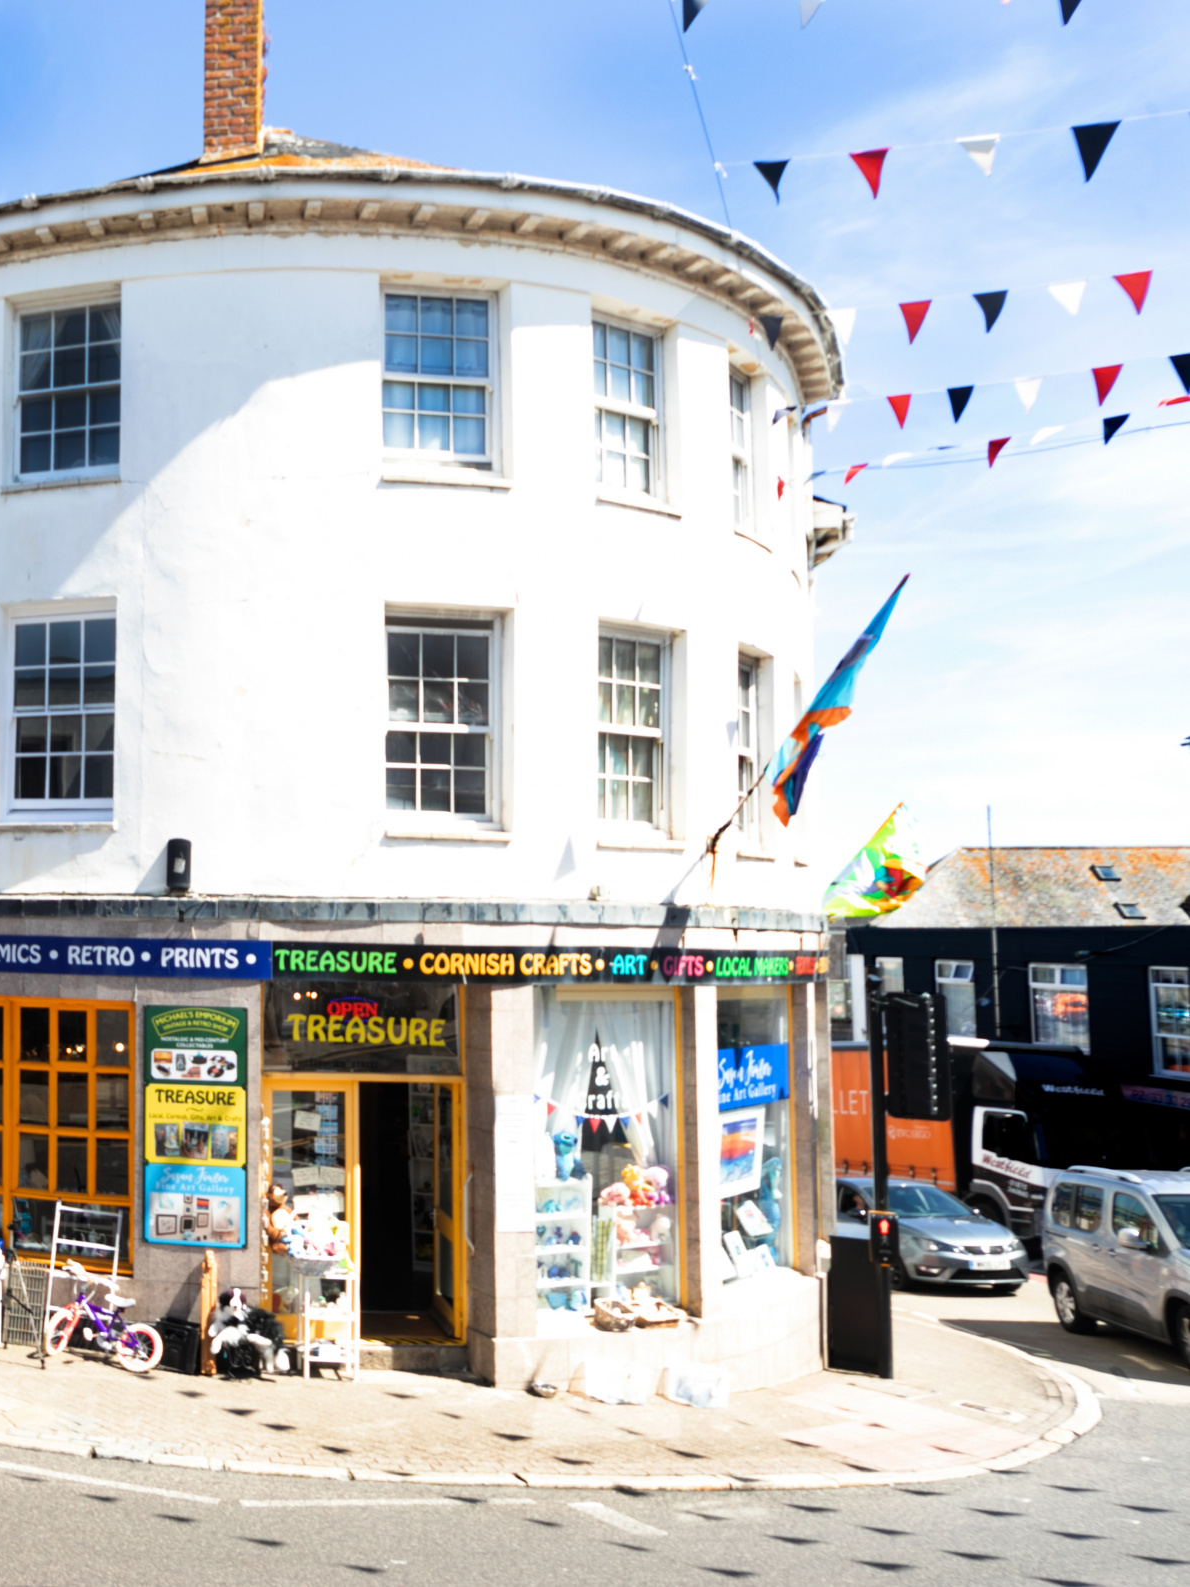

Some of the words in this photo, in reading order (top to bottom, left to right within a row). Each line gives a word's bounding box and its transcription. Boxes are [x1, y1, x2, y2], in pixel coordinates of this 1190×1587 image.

[67, 945, 135, 967] RETRO
[160, 947, 239, 969] PRINTS
[274, 949, 397, 974] TREASURE
[419, 952, 515, 976] CORNISH
[519, 952, 592, 976] CRAFTS
[612, 954, 648, 976] ART
[663, 955, 704, 977] GIFTS
[715, 956, 752, 977] LOCAL
[754, 956, 789, 977] MAKERS
[155, 1011, 194, 1026] MICHAEL'S
[195, 1010, 236, 1028] EMPORIUM
[326, 1001, 378, 1018] OPEN
[287, 1013, 446, 1047] TREASURE
[595, 1066, 610, 1086] &
[155, 1089, 236, 1106] TREASURE
[733, 1088, 747, 1101] Art
[748, 1081, 777, 1099] Gallery
[1041, 1083, 1105, 1096] Westfield
[982, 1153, 1033, 1179] Westfield
[155, 1181, 176, 1190] Fine
[180, 1183, 196, 1191] Art
[198, 1184, 234, 1195] Gallery
